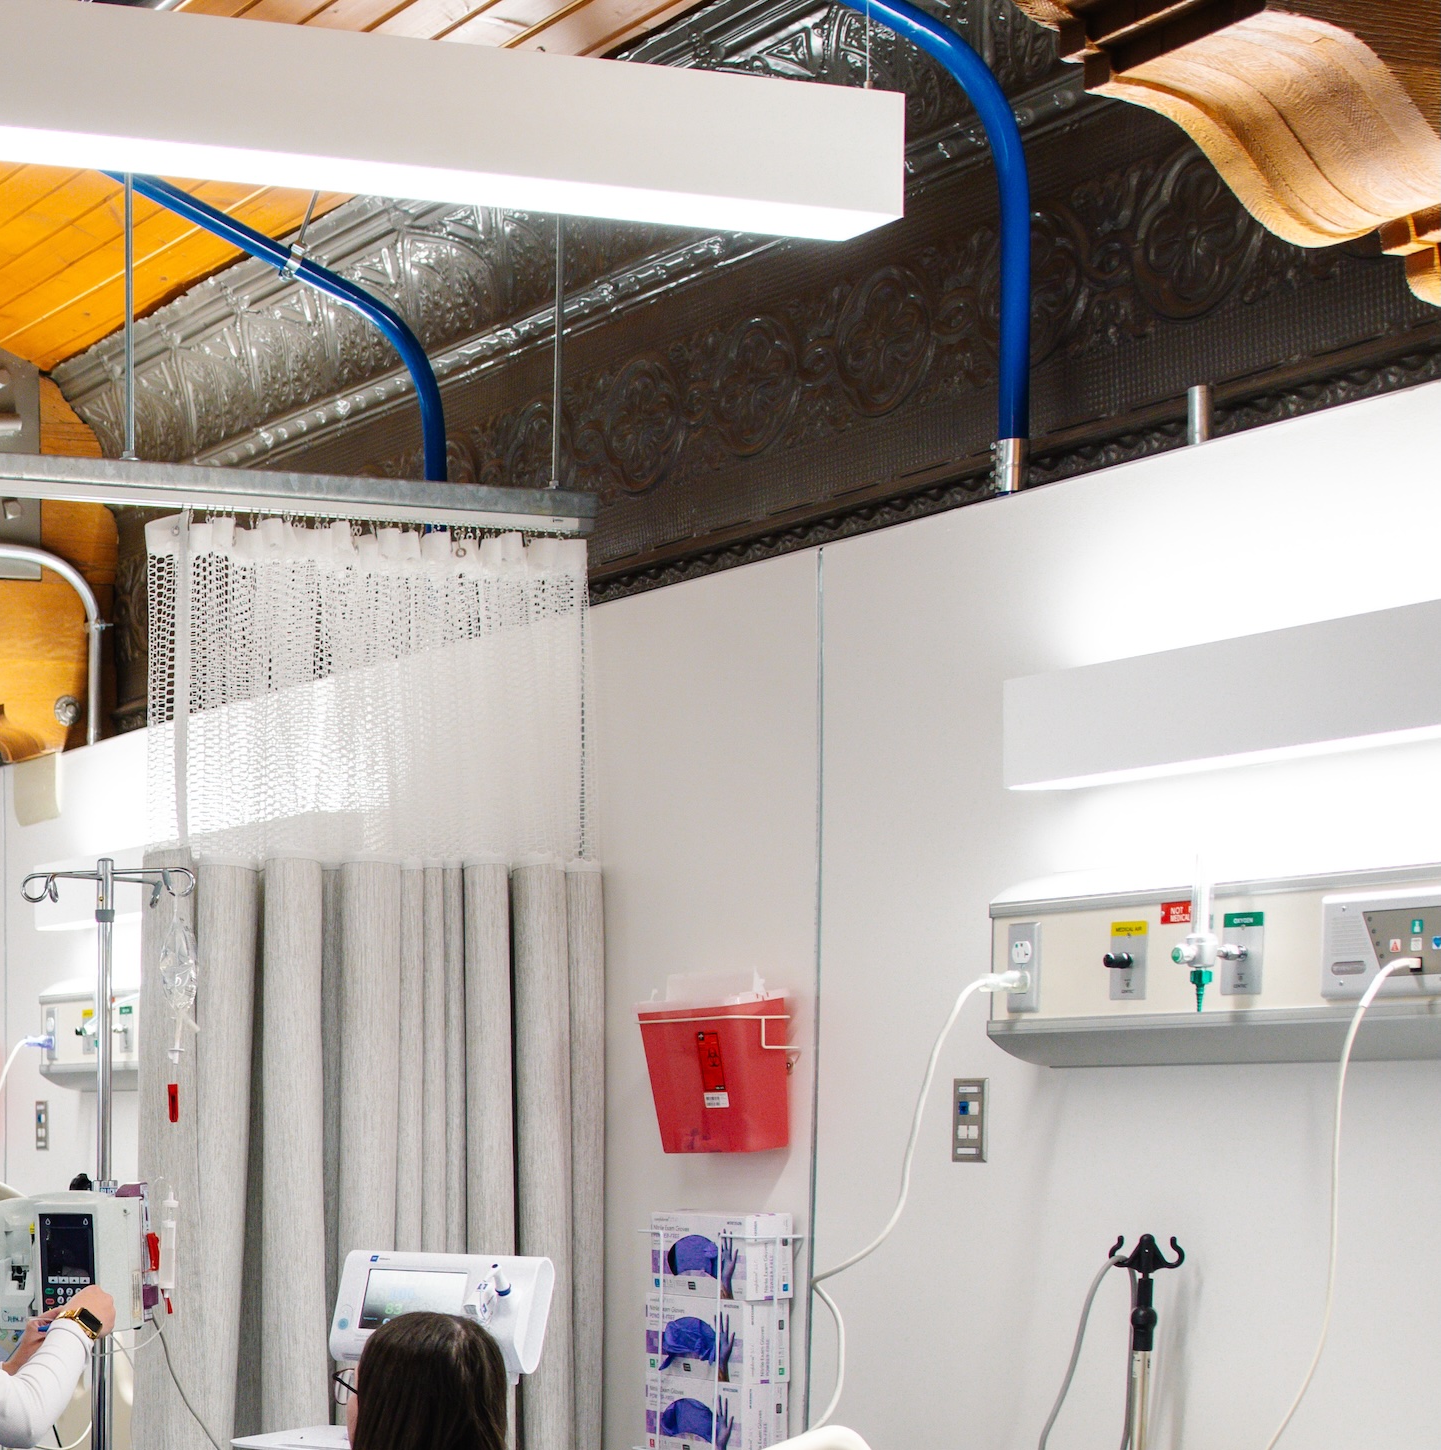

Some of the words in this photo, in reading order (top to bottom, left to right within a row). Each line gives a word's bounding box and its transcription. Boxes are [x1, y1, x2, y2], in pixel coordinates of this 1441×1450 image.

[1170, 907, 1183, 915] NOT
[1170, 913, 1191, 922] MEDICAL
[385, 1303, 403, 1315] 83
